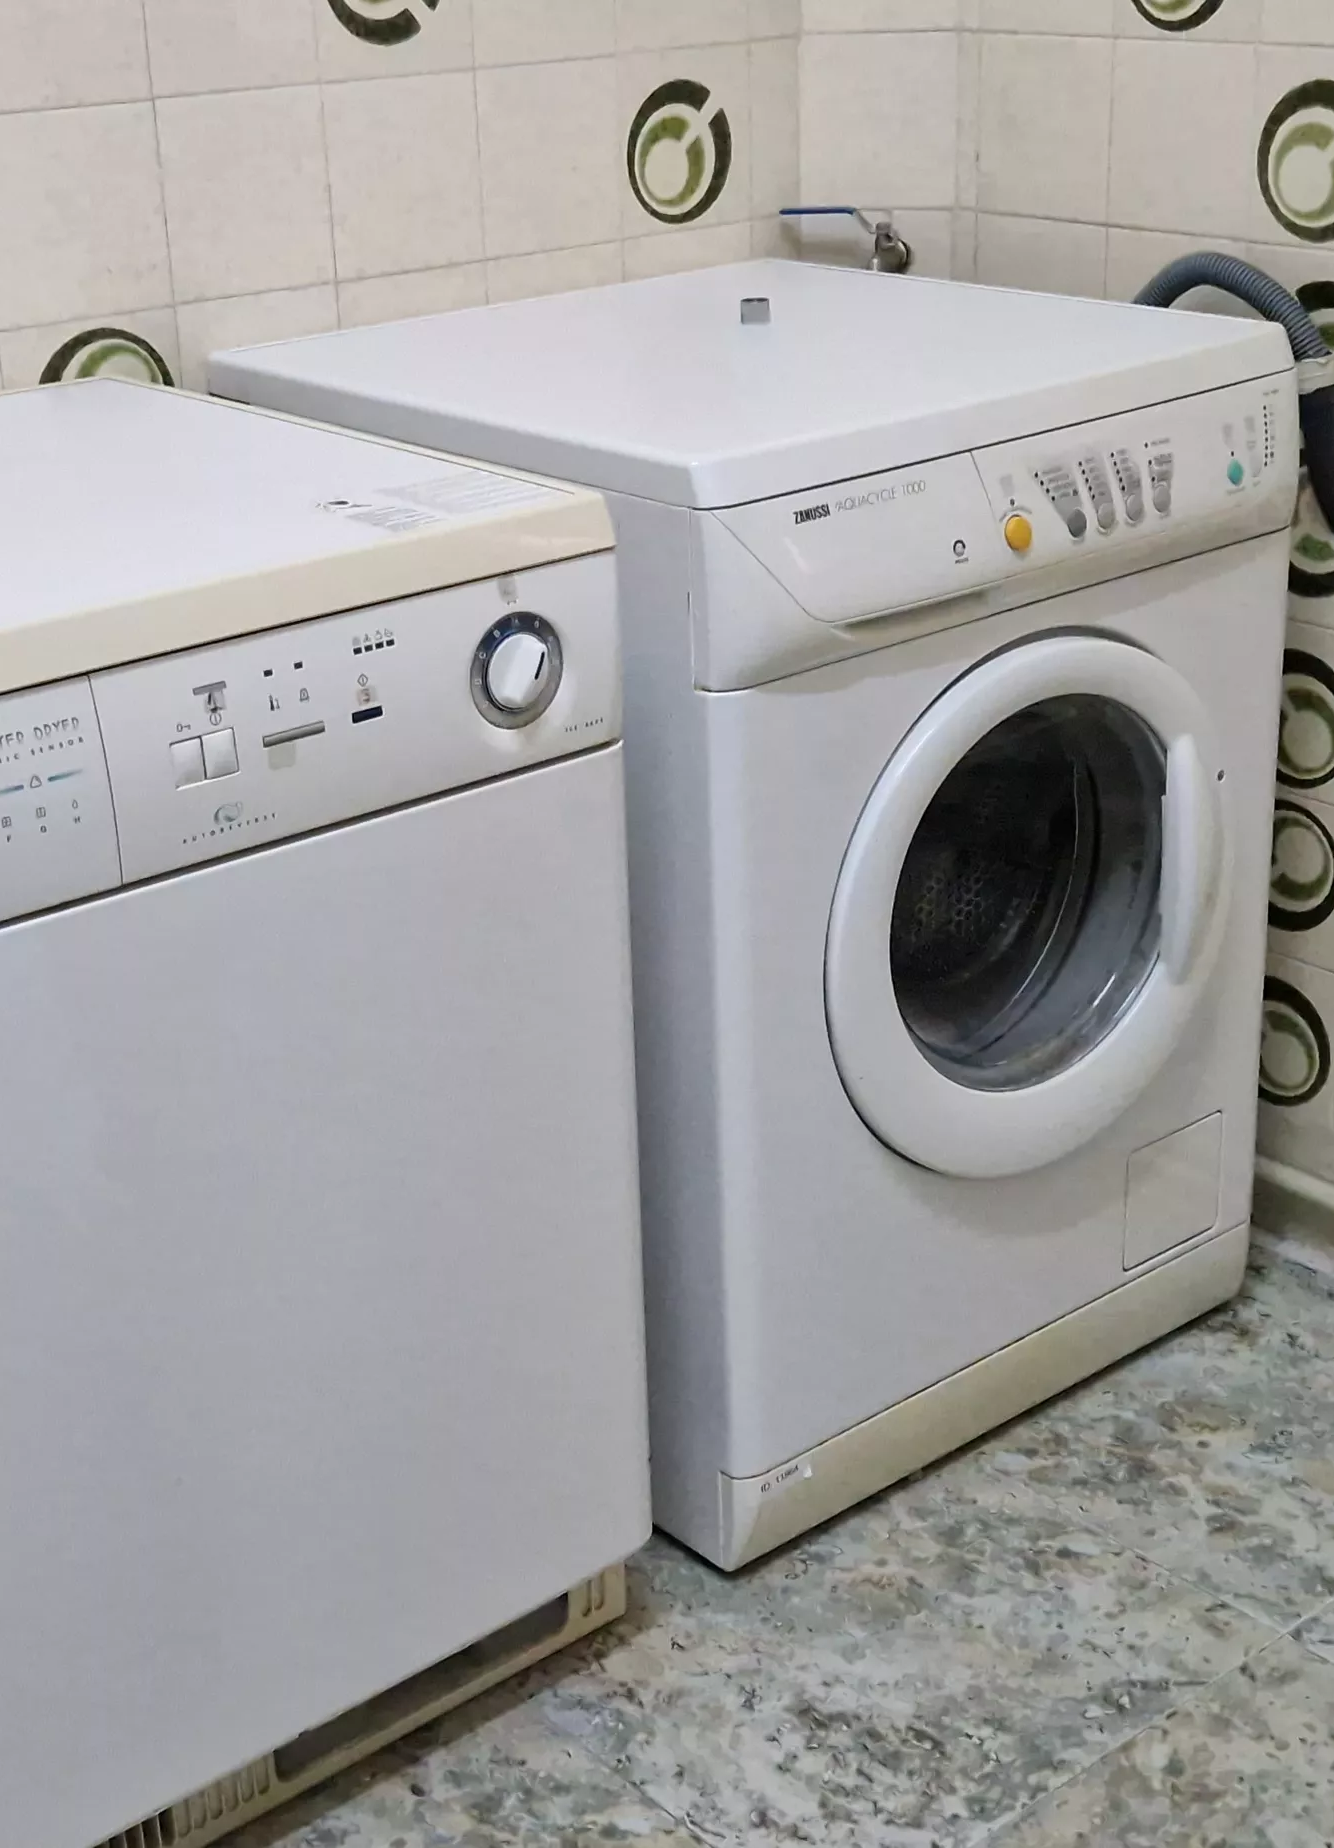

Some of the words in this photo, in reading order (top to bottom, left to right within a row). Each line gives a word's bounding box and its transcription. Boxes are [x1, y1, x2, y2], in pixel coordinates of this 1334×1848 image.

[792, 503, 831, 525] ZANUSSI
[901, 479, 926, 497] 1000
[30, 736, 84, 756] SENSOR
